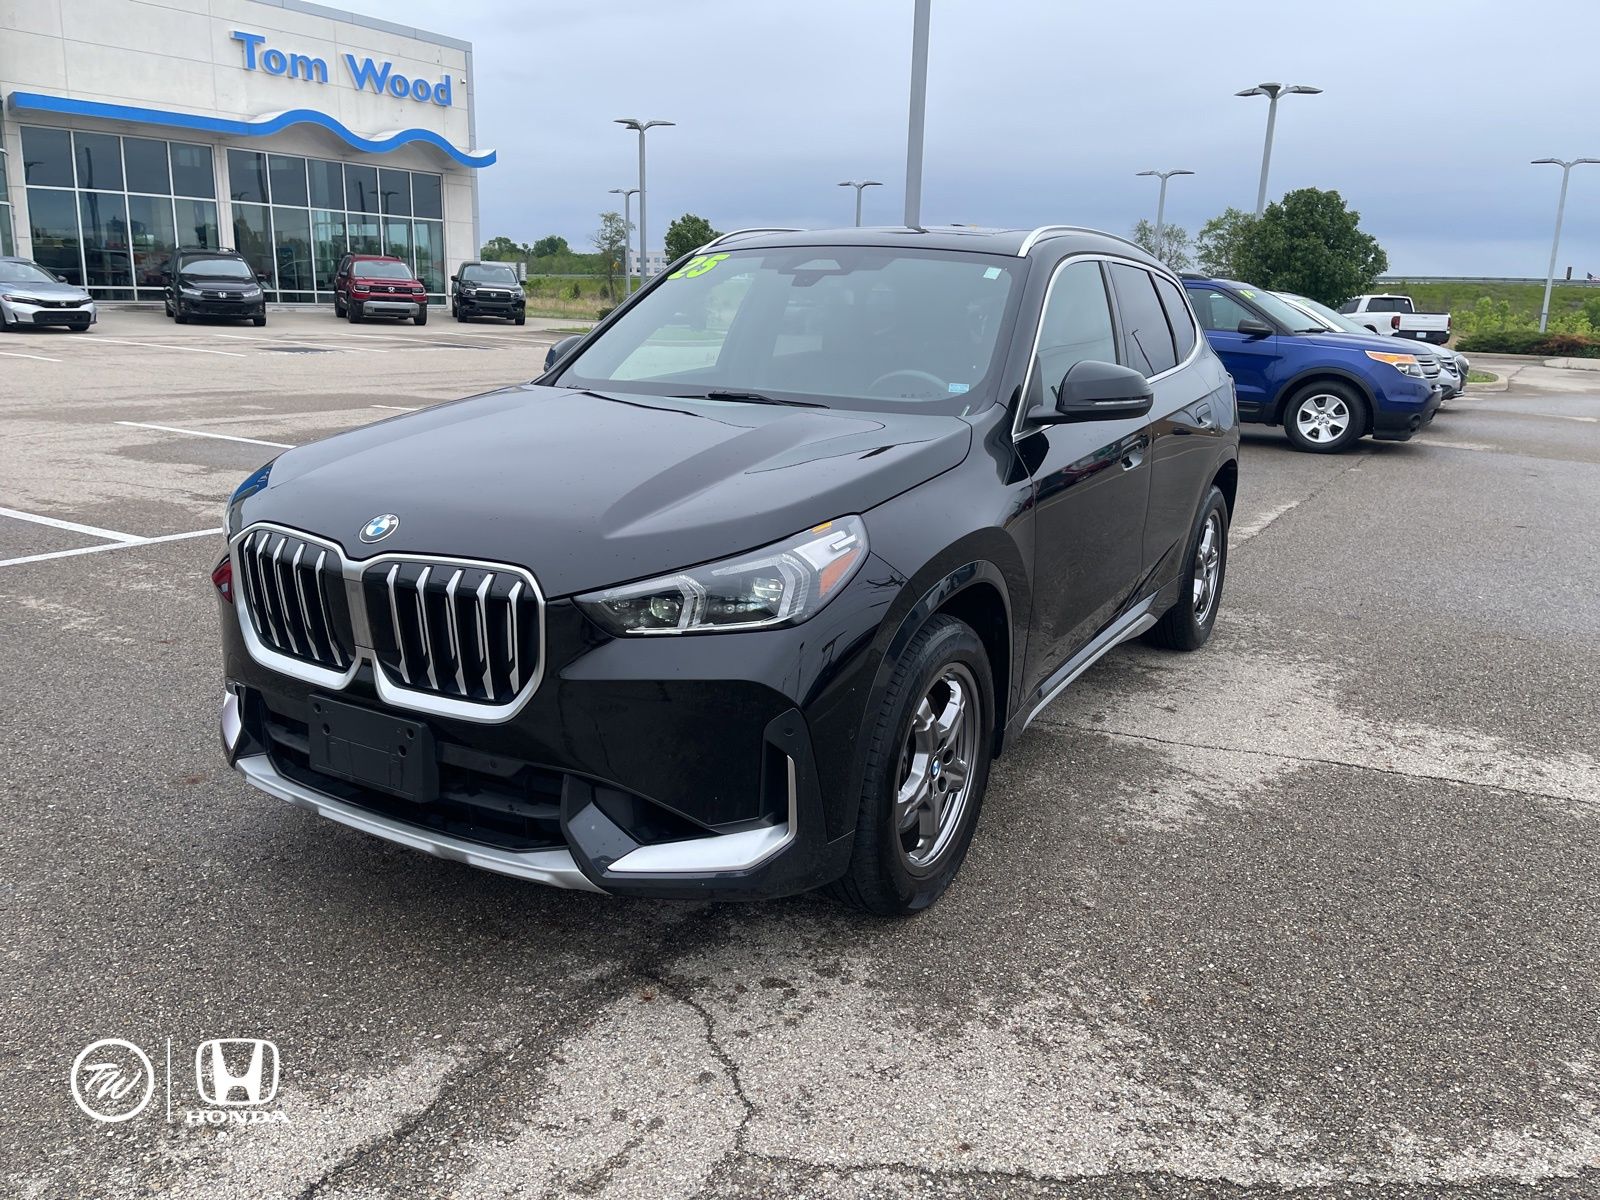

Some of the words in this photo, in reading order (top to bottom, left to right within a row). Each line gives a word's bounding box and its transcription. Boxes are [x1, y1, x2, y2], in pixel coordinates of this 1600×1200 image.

[230, 31, 329, 83] Tom
[342, 53, 453, 107] Wood
[667, 253, 730, 280] 25
